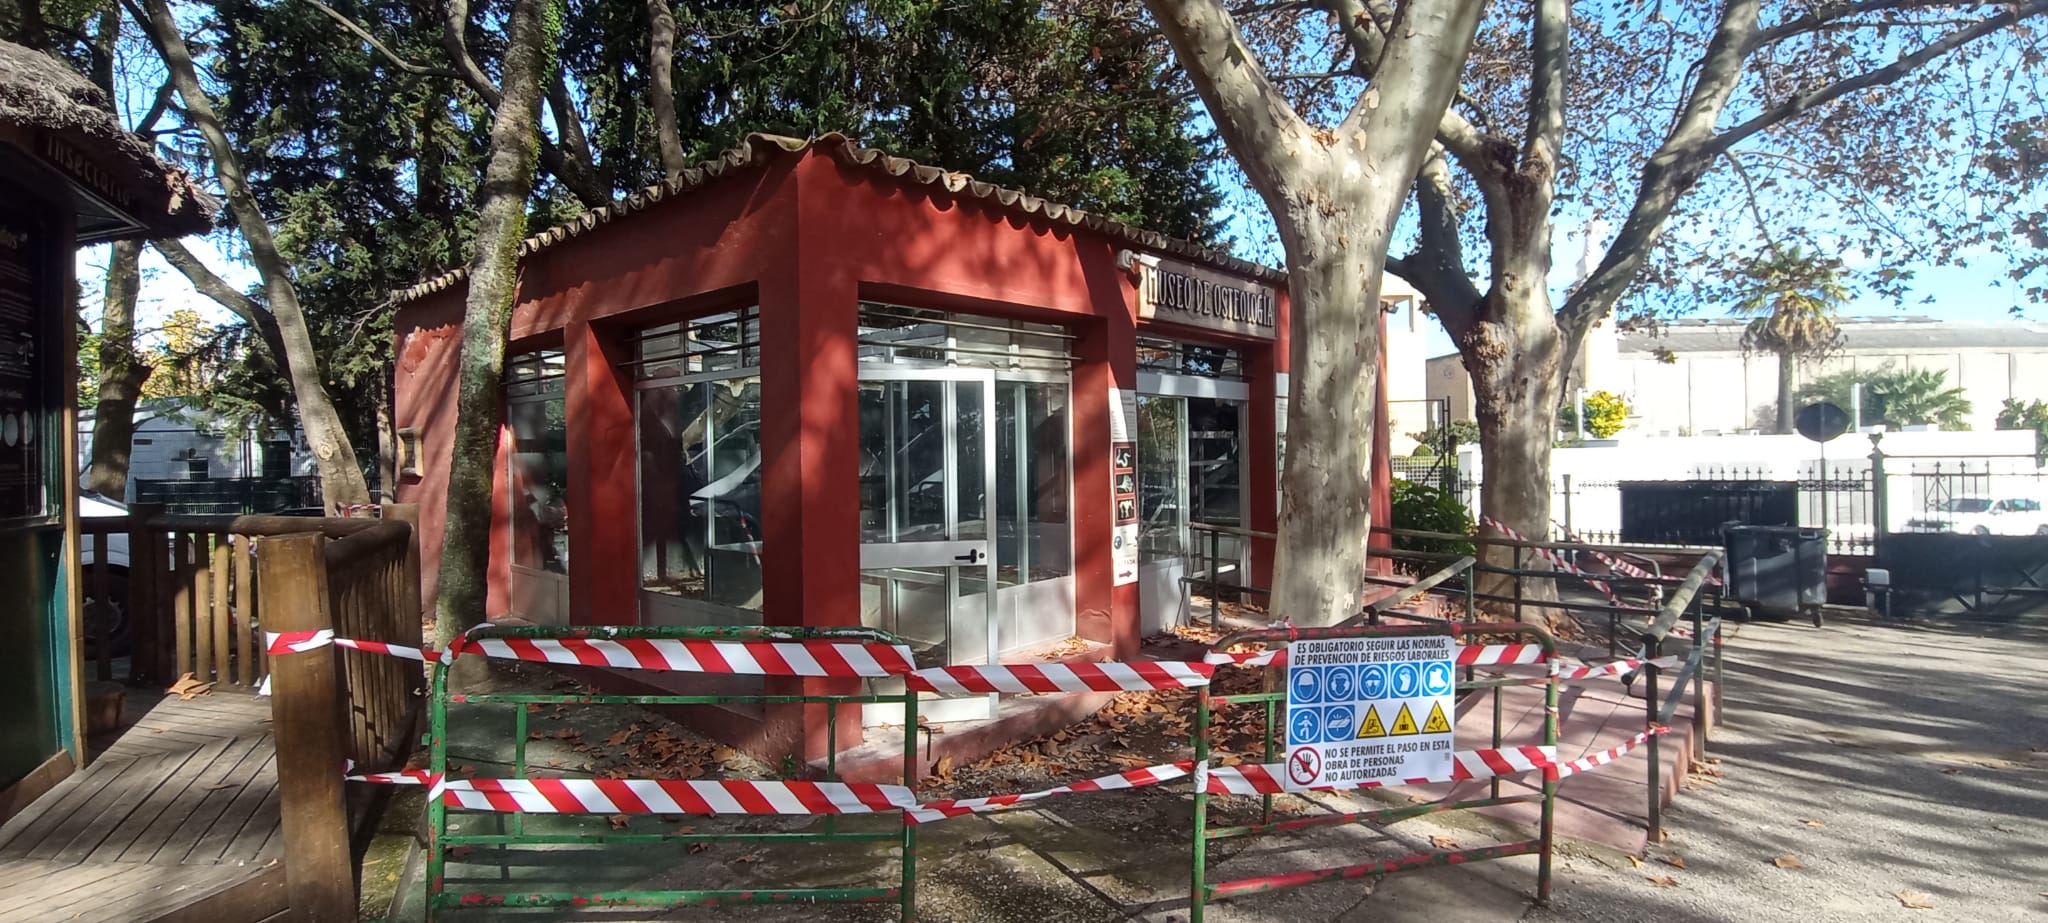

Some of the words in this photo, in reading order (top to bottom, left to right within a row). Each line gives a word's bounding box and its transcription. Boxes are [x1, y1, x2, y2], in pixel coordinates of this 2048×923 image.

[1147, 267, 1192, 310] MUSEO
[1195, 279, 1210, 314] DE
[1213, 284, 1274, 327] OSTEOLOGÍA
[1297, 643, 1306, 654] ES
[1308, 641, 1364, 653] OBLIGATORIO
[1366, 640, 1395, 652] SEGUIR
[1396, 639, 1410, 650] LAS
[1412, 638, 1446, 649] NORMAS
[1295, 654, 1305, 666] DE
[1307, 653, 1359, 665] PREVENCION
[1361, 652, 1372, 663] DE
[1373, 650, 1406, 662] RIESGOS
[1407, 649, 1450, 661] LABORALES
[1324, 748, 1338, 759] NO
[1339, 746, 1349, 758] SE
[1351, 744, 1385, 757] PERMITE
[1386, 743, 1396, 754] EL
[1397, 742, 1418, 753] PASO
[1420, 741, 1431, 752] EN
[1432, 740, 1450, 751] ESTA
[1325, 759, 1348, 771] OBRA
[1350, 757, 1361, 769] DE
[1363, 755, 1405, 767] PERSONAS
[1325, 772, 1338, 782] NO
[1340, 767, 1397, 781] AUTORIZADAS
